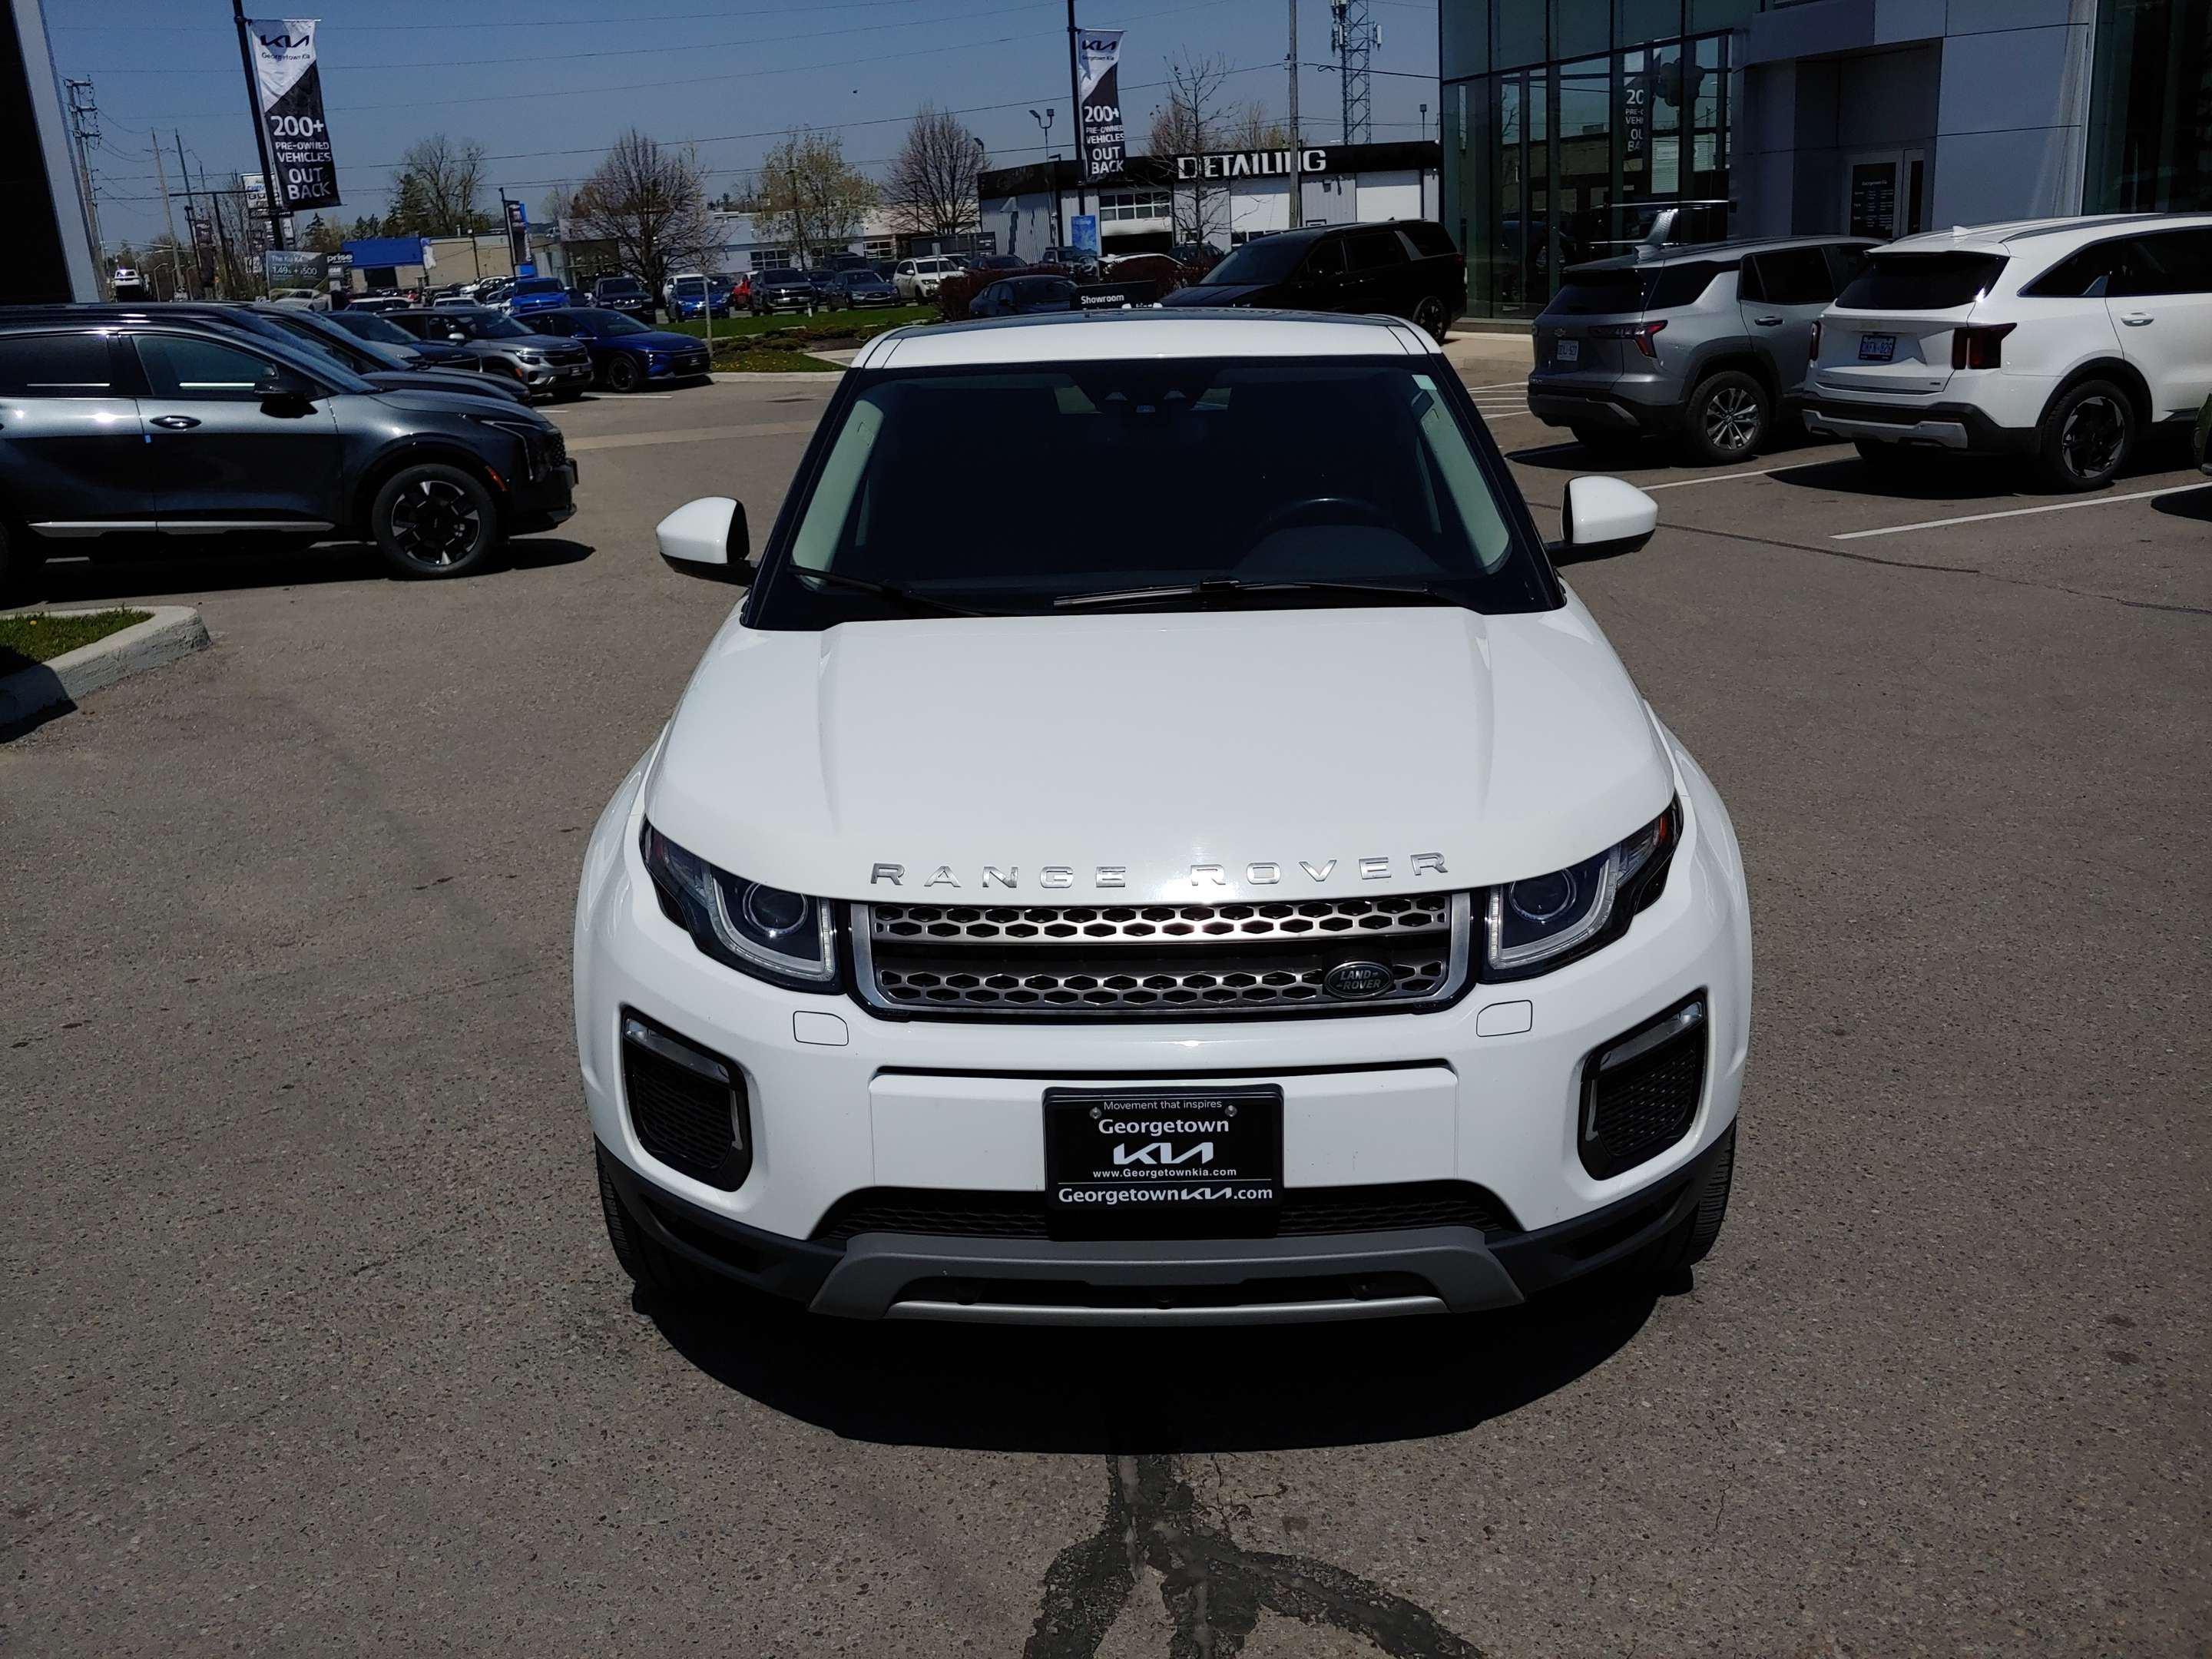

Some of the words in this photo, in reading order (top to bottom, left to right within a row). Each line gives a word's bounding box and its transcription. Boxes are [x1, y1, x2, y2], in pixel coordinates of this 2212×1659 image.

[262, 52, 301, 61] Georgetown
[1084, 105, 1120, 122] 200+
[270, 116, 324, 137] 200+
[1086, 124, 1124, 134] PRE-OWNED
[275, 141, 329, 150] PRE-OWNED
[1086, 134, 1124, 144] VEHICLES
[276, 152, 332, 163] VEHICLES
[1092, 146, 1121, 161] OUT
[1091, 160, 1124, 174] BACK
[288, 167, 323, 184] OUT
[287, 181, 331, 200] BACK
[1081, 294, 1124, 304] Showroom
[870, 863, 1126, 889] RANGE
[1190, 852, 1449, 886] ROVER
[1103, 1101, 1158, 1111] Movement
[1160, 1100, 1181, 1109] that
[1183, 1099, 1223, 1110] inspires
[1098, 1118, 1230, 1137] Georgetown
[1114, 1142, 1214, 1165] KIA
[1093, 1167, 1237, 1179] www.Georgetownkia.com
